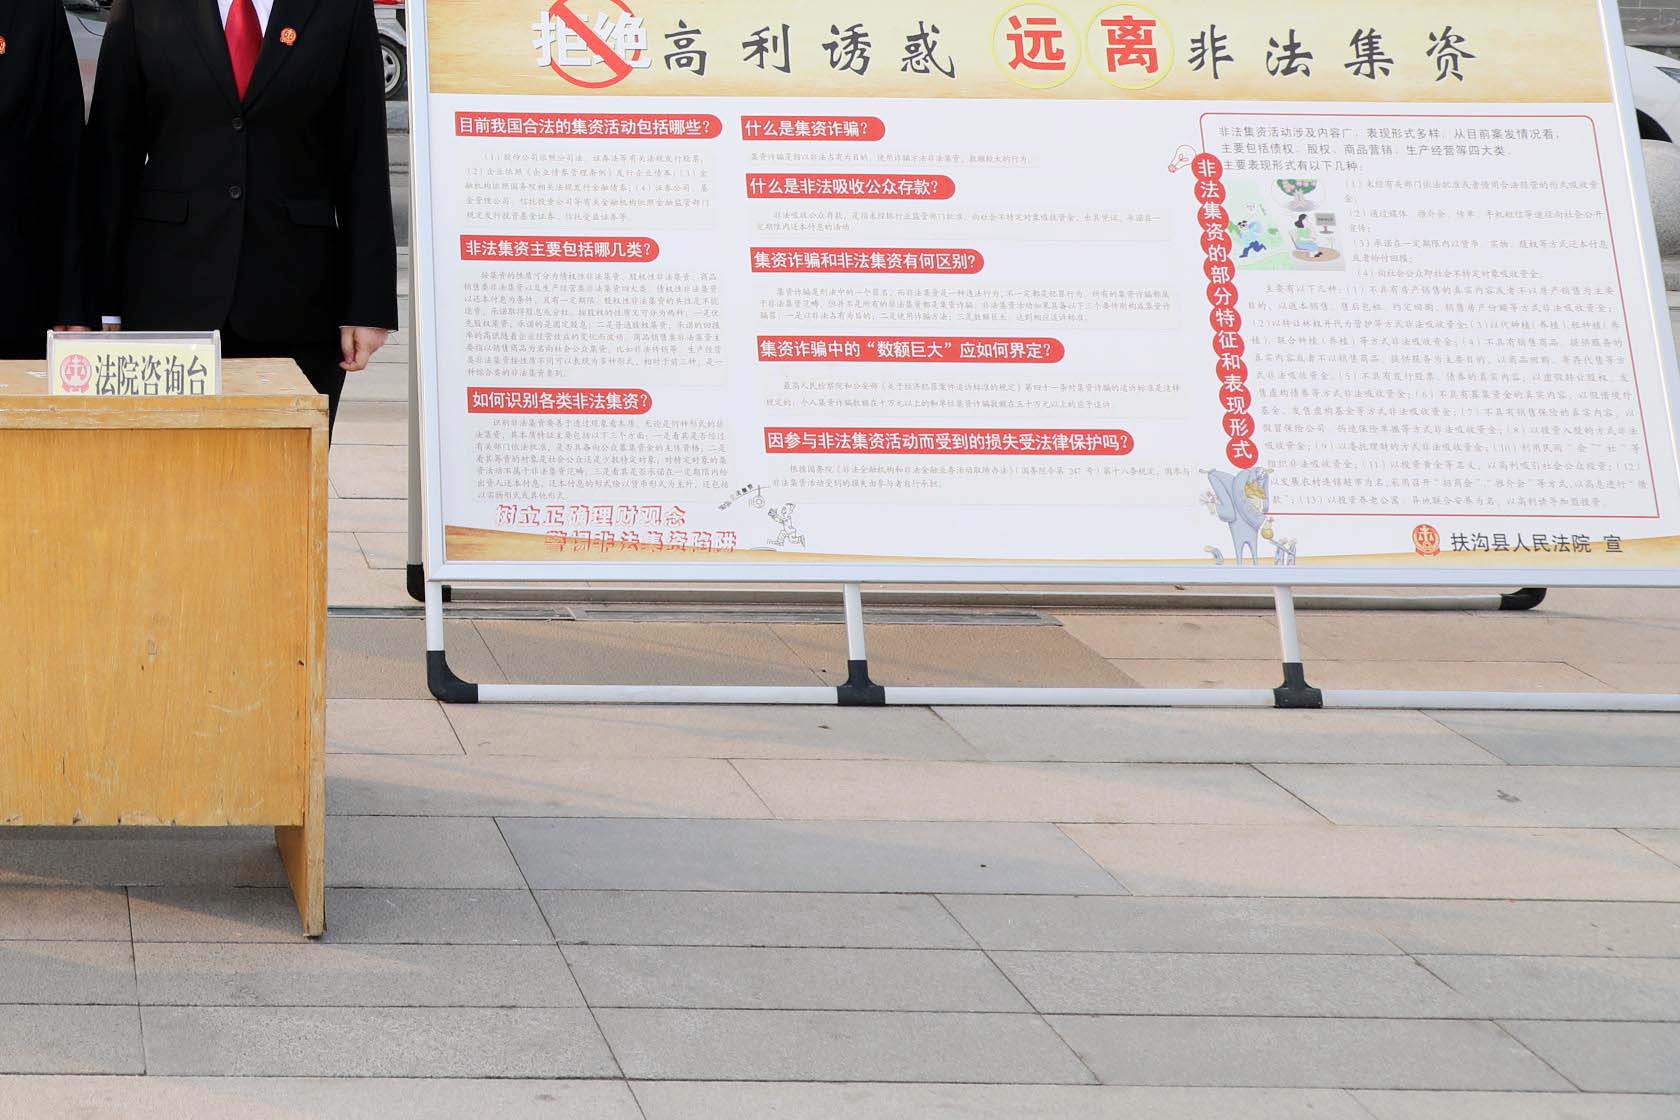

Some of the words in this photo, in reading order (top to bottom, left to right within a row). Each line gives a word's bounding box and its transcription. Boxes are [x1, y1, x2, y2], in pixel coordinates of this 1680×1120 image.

[663, 20, 956, 79] 高利诱惑
[1006, 14, 1158, 74] 远离
[1188, 24, 1478, 82] 非法集资
[459, 116, 711, 137] 目前我国合法的集资活动包括哪些？
[745, 118, 871, 138] 什么是集资诈骗？
[750, 177, 941, 197] 什么是非法吸收公众存款？
[465, 239, 653, 260] 非法集资主要包括哪几类？
[753, 250, 976, 271] 集资诈骗和非法集资有何区别？
[1197, 158, 1253, 461] 非法集资的部分特征和表现形式
[760, 339, 1053, 360] 集资诈骗中的“数额巨大”应如何界定？
[95, 353, 208, 395] 法院咨询台
[472, 391, 650, 411] 如何识别各类非法集资？
[767, 430, 1130, 452] 因参与非法集资活动而受到的损失受法律保护吗？
[1451, 532, 1592, 555] 扶沟县人民法院
[1603, 534, 1624, 555] 宣
